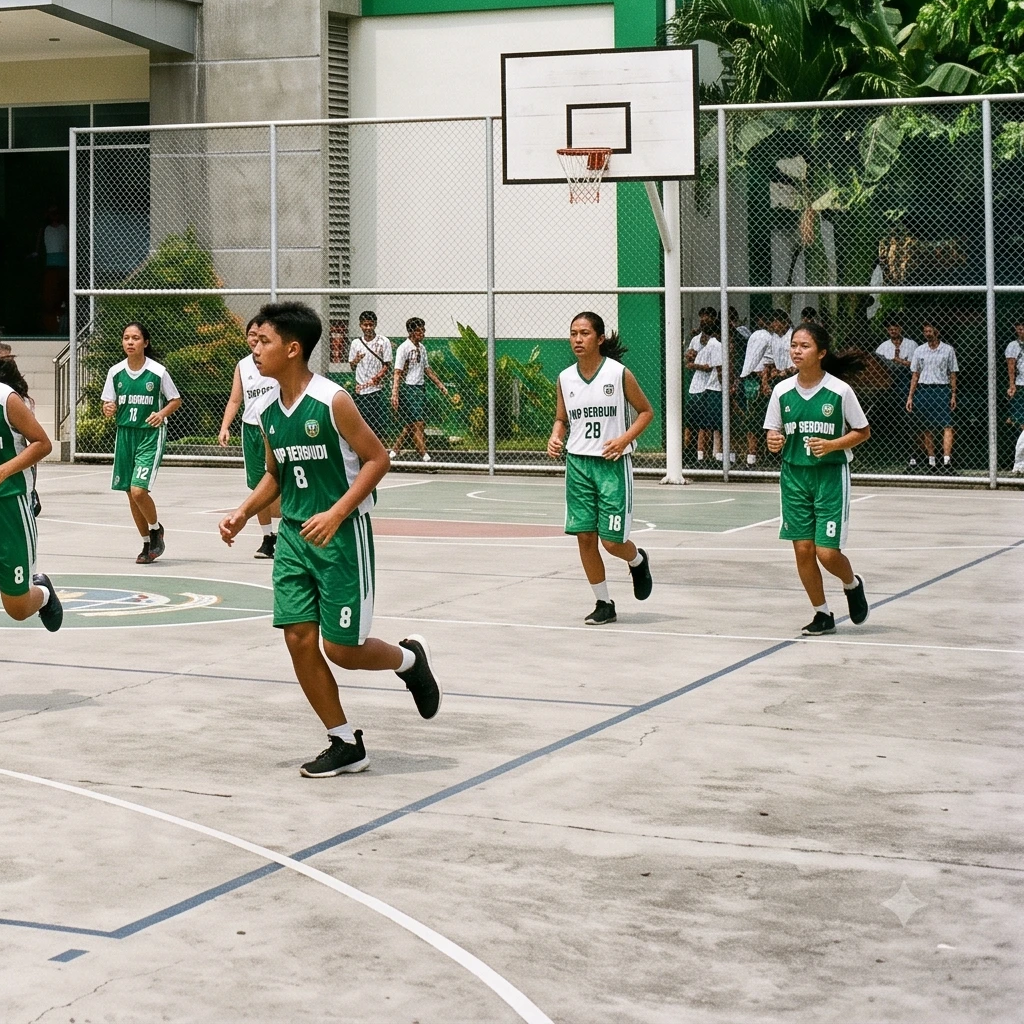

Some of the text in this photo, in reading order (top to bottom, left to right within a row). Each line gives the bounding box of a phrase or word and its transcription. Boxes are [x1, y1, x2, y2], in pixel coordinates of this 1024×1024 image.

[136, 466, 149, 480] 12
[293, 466, 309, 489] 8
[608, 514, 622, 532] 18
[826, 521, 836, 538] 8
[14, 566, 24, 585] 8
[339, 606, 352, 629] 8
